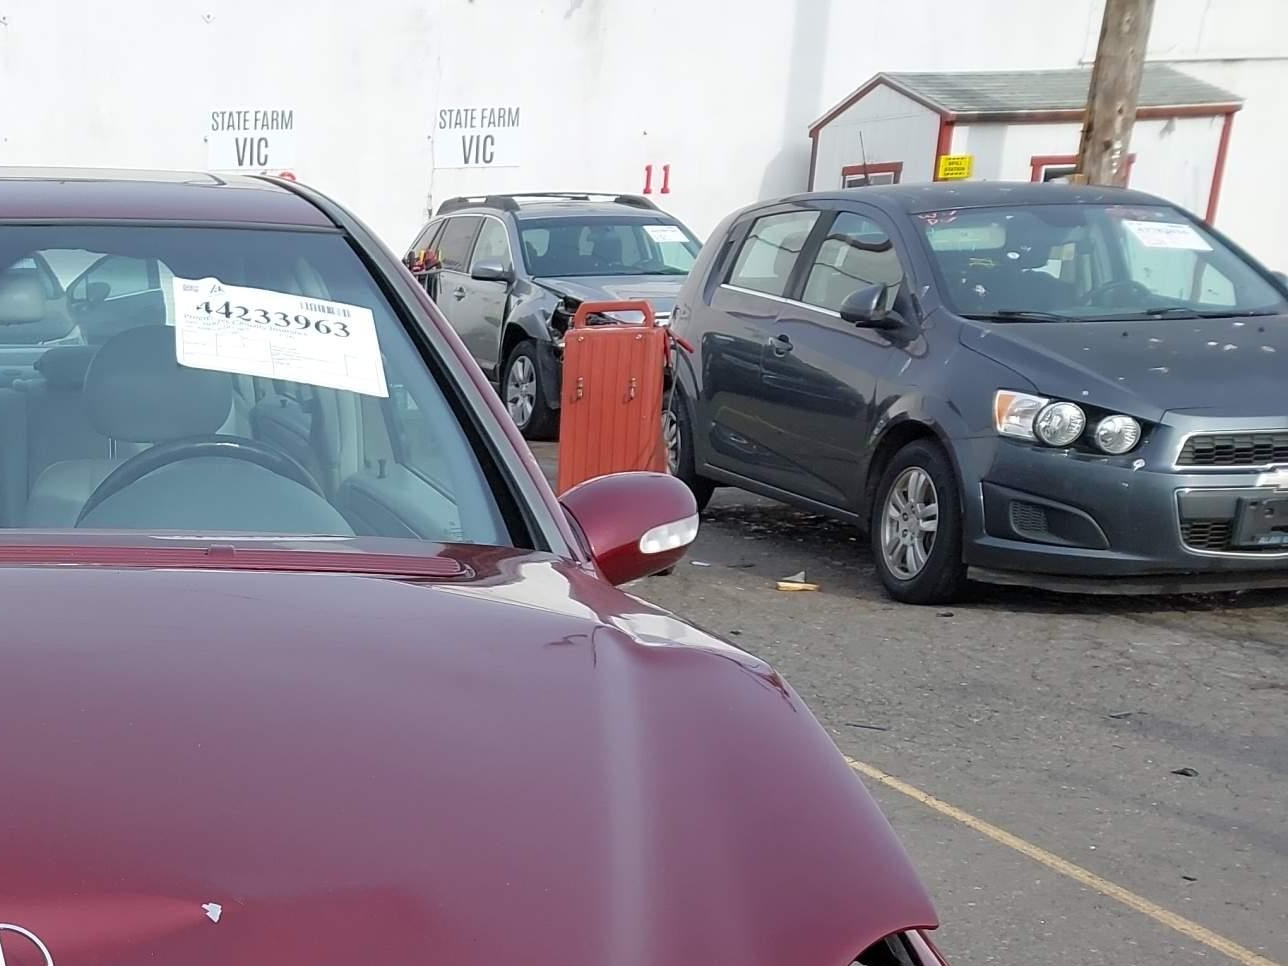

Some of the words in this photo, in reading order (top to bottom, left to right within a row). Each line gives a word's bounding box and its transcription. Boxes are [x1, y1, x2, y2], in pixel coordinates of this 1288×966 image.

[211, 110, 250, 132] STATE
[253, 110, 293, 132] FARM
[438, 107, 477, 130] STATE
[480, 107, 520, 130] FARM
[234, 136, 269, 168] VIC
[461, 134, 495, 166] VIC
[643, 165, 670, 194] 11
[196, 301, 350, 338] 44233963
